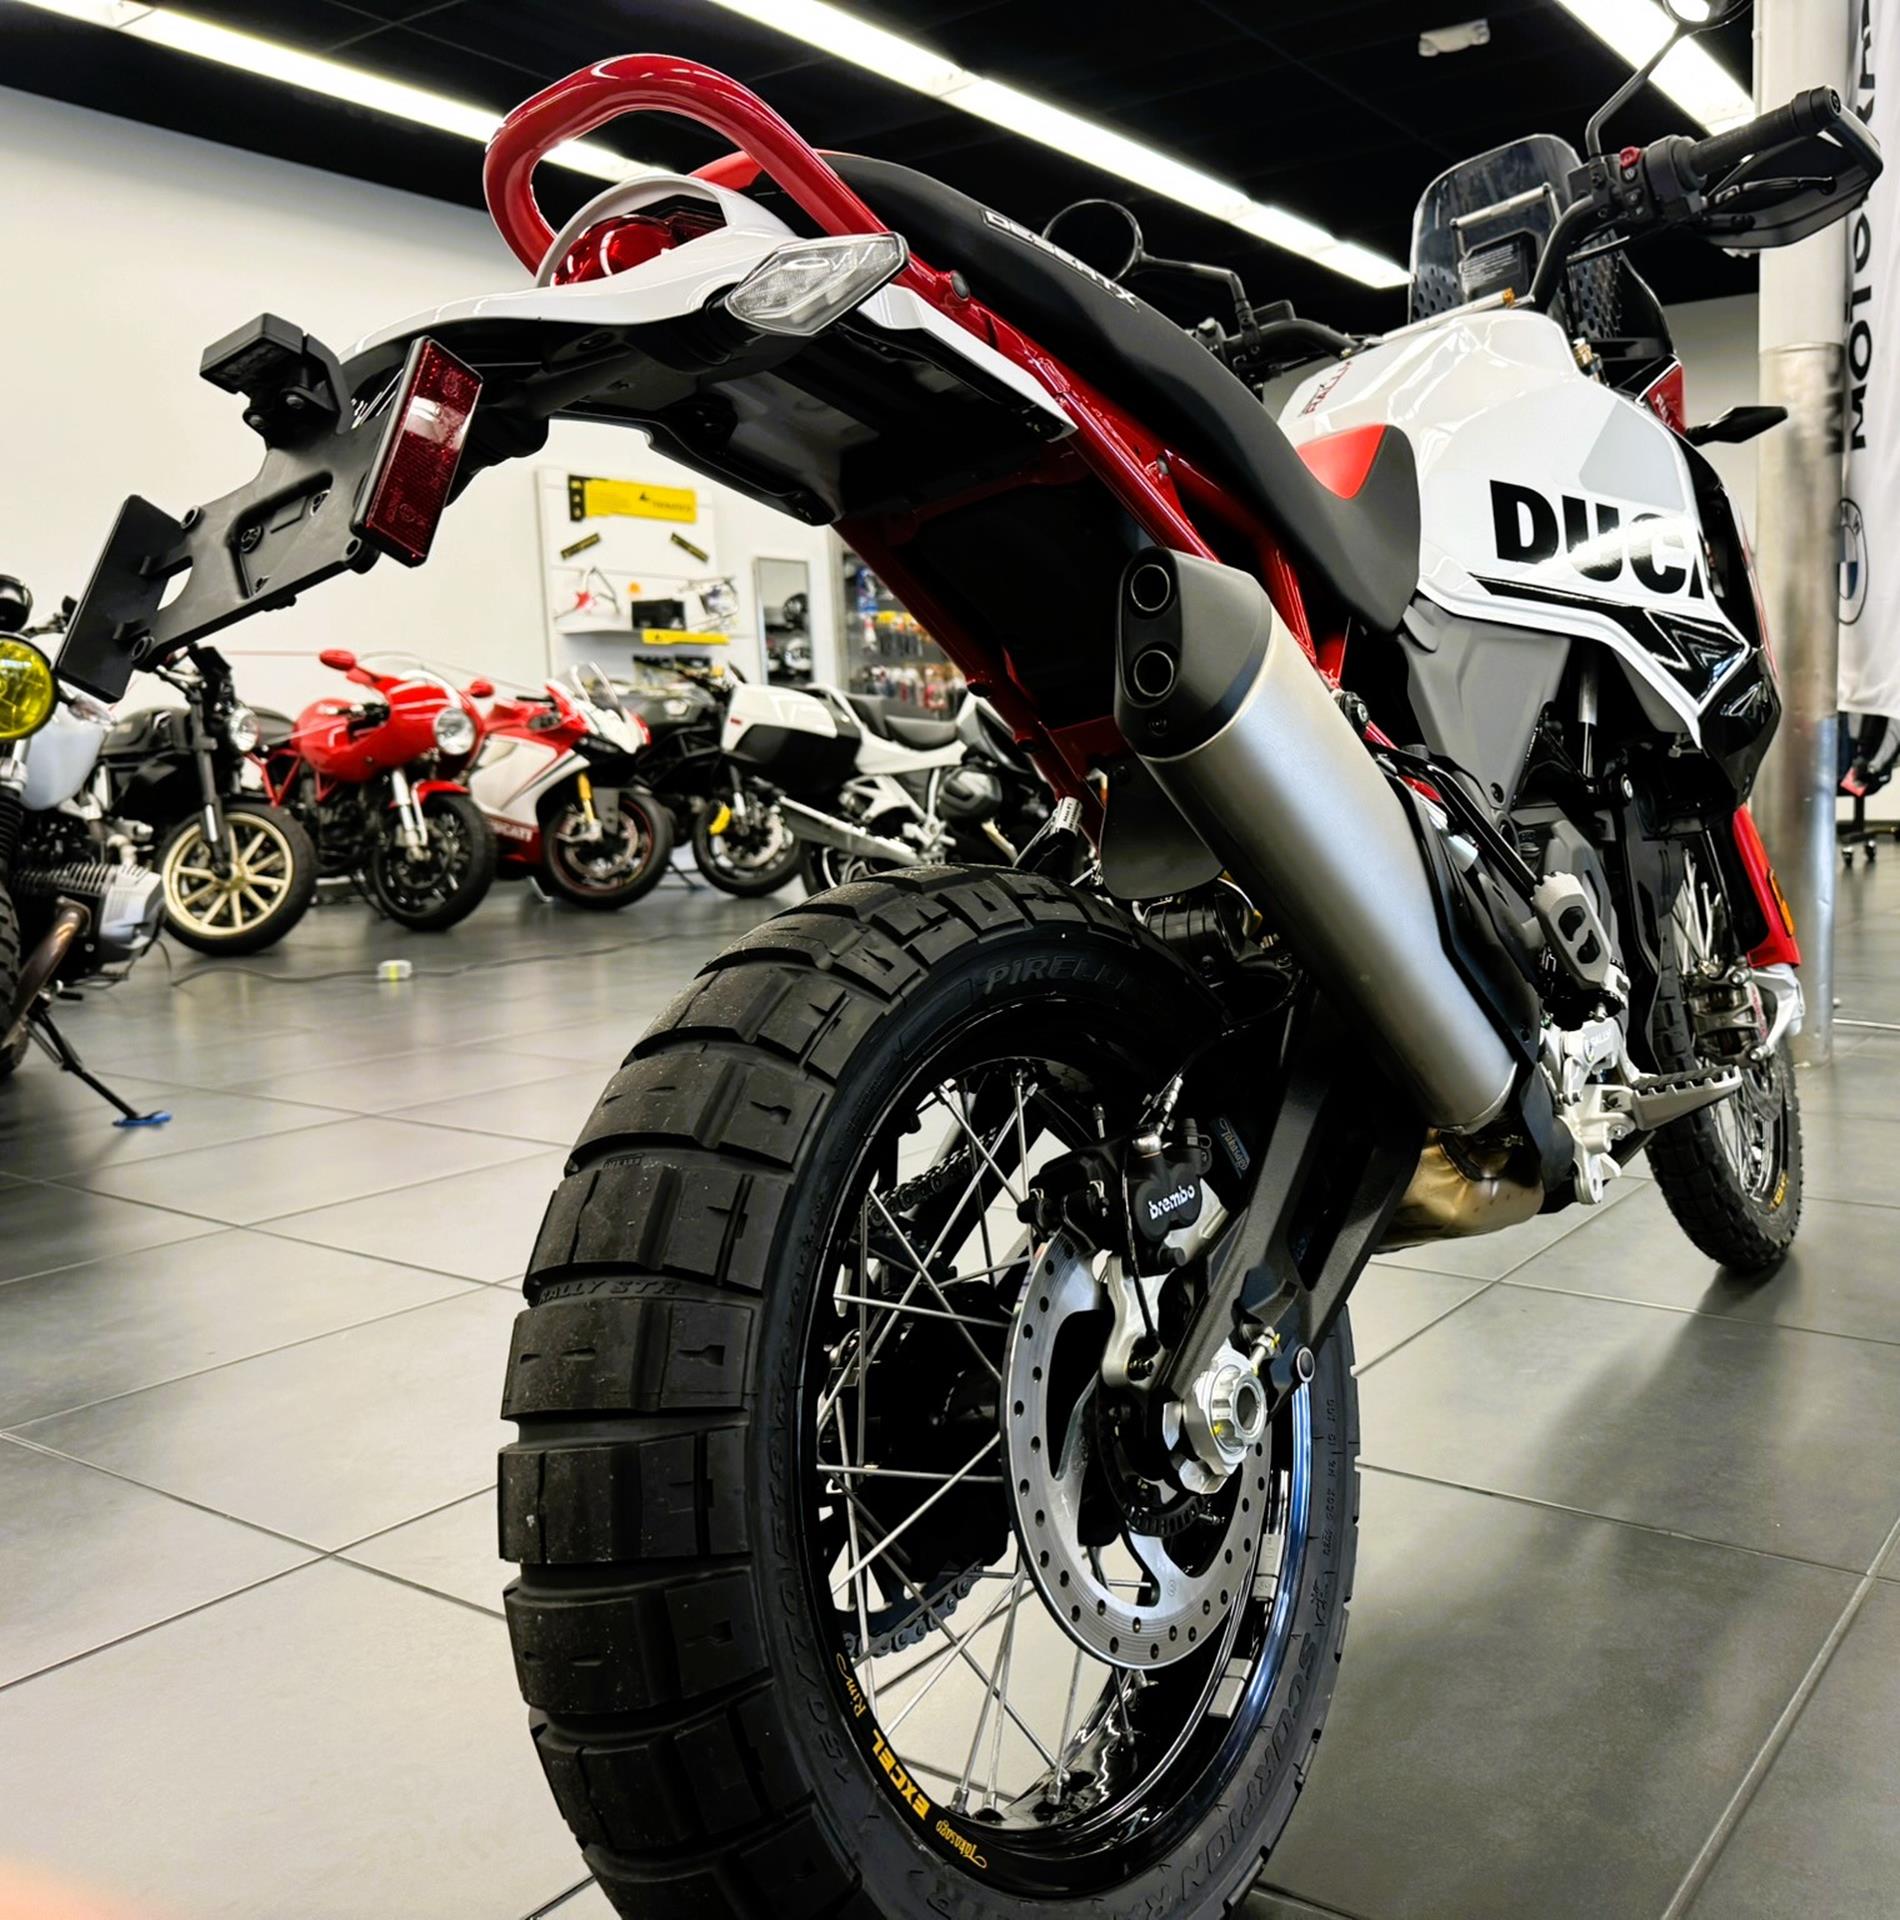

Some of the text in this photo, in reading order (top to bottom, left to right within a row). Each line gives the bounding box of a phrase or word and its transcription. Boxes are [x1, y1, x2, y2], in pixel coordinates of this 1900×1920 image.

[985, 211, 1140, 307] DESERTX
[1148, 1184, 1196, 1220] brembo
[872, 1728, 931, 1821] EXCEL
[1181, 1631, 1316, 1900] SCORPION
[936, 1819, 988, 1869] Takasago
